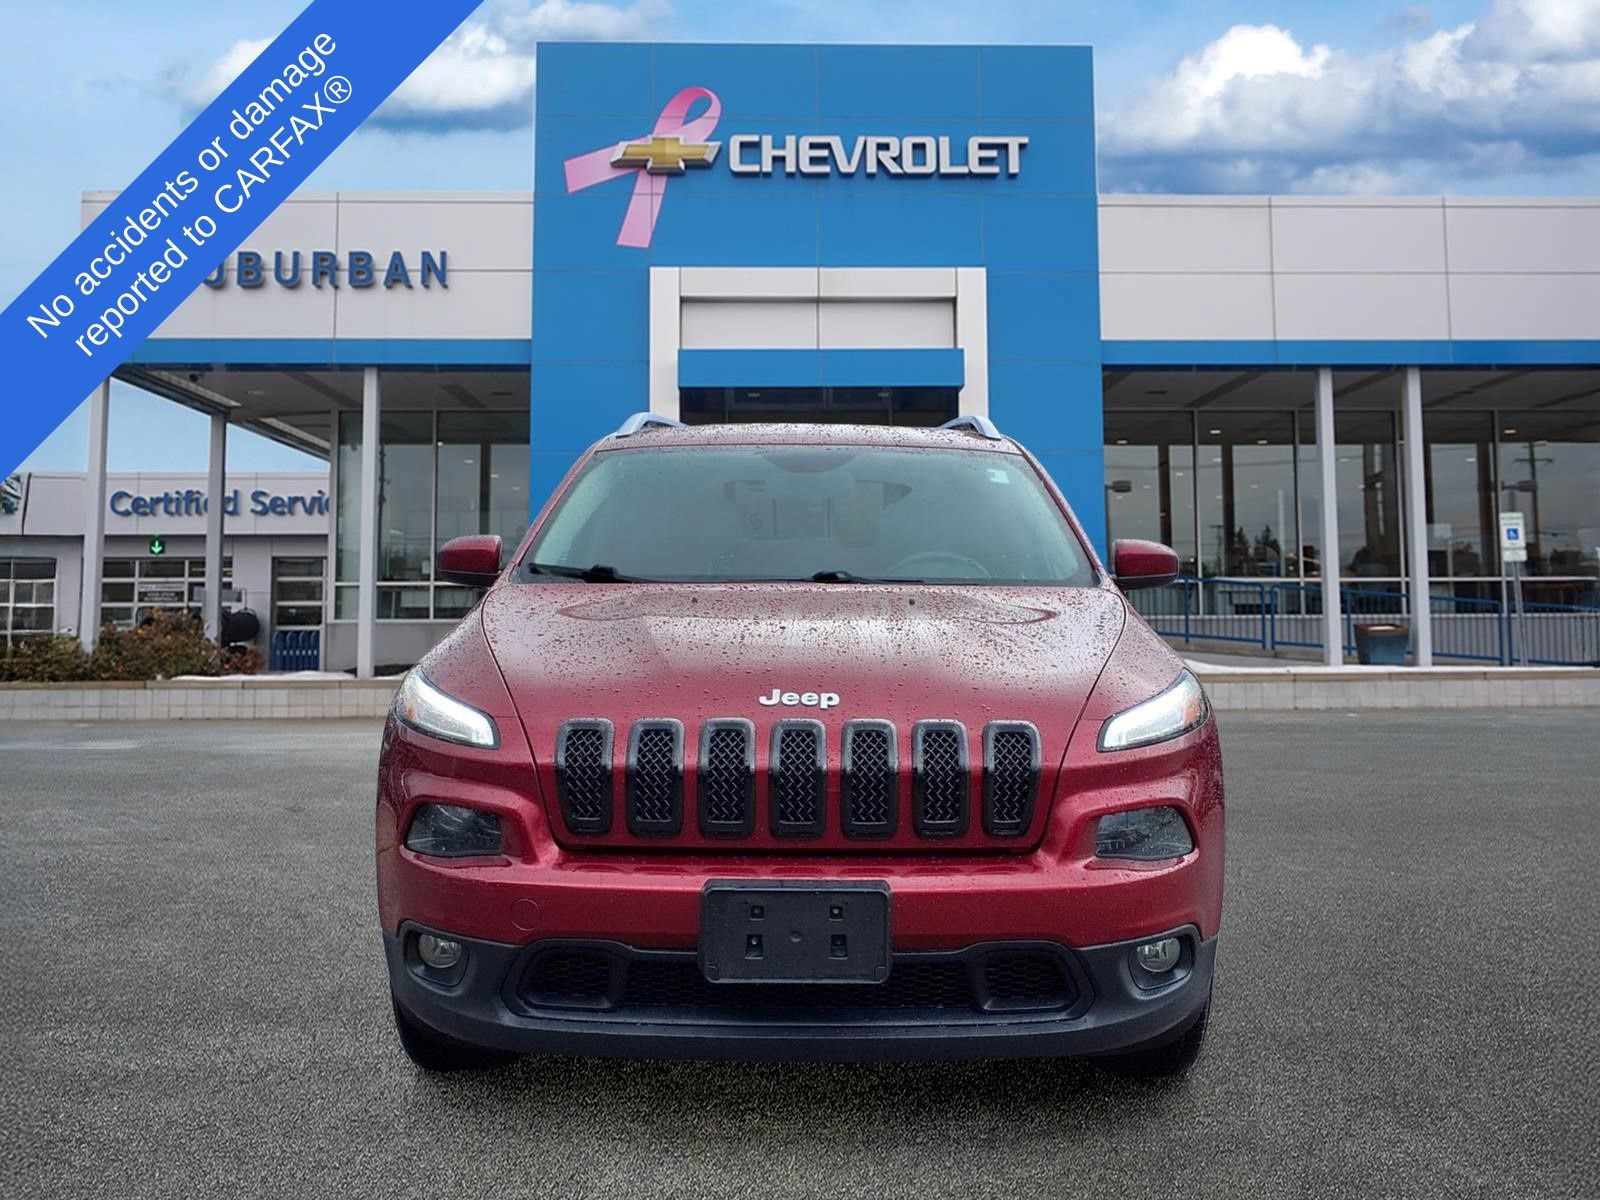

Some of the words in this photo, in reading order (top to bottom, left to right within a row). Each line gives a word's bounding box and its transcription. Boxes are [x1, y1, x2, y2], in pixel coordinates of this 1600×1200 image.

[728, 134, 1029, 175] CHEVROLET
[201, 251, 448, 290] UBURBAN
[250, 489, 330, 516] Servi
[758, 688, 841, 710] Jeep
